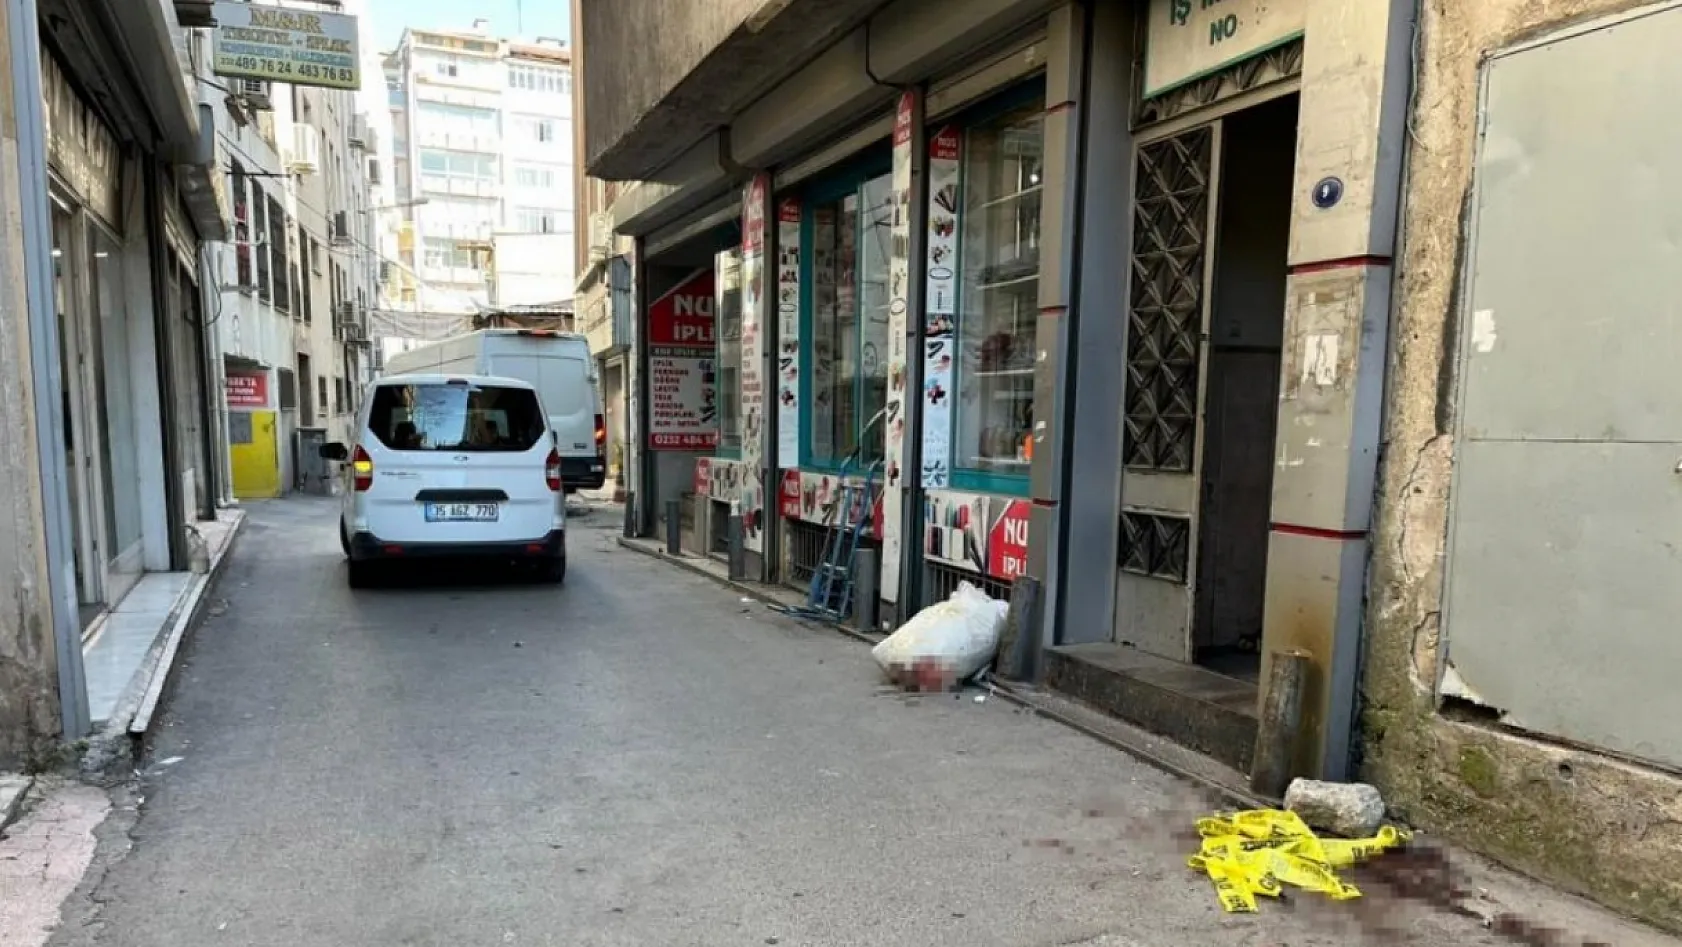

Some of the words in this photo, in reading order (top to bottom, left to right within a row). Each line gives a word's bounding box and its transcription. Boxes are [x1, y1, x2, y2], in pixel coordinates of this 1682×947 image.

[1210, 14, 1237, 45] NO
[235, 57, 257, 70] 489
[261, 59, 274, 72] 76
[278, 61, 292, 74] 24
